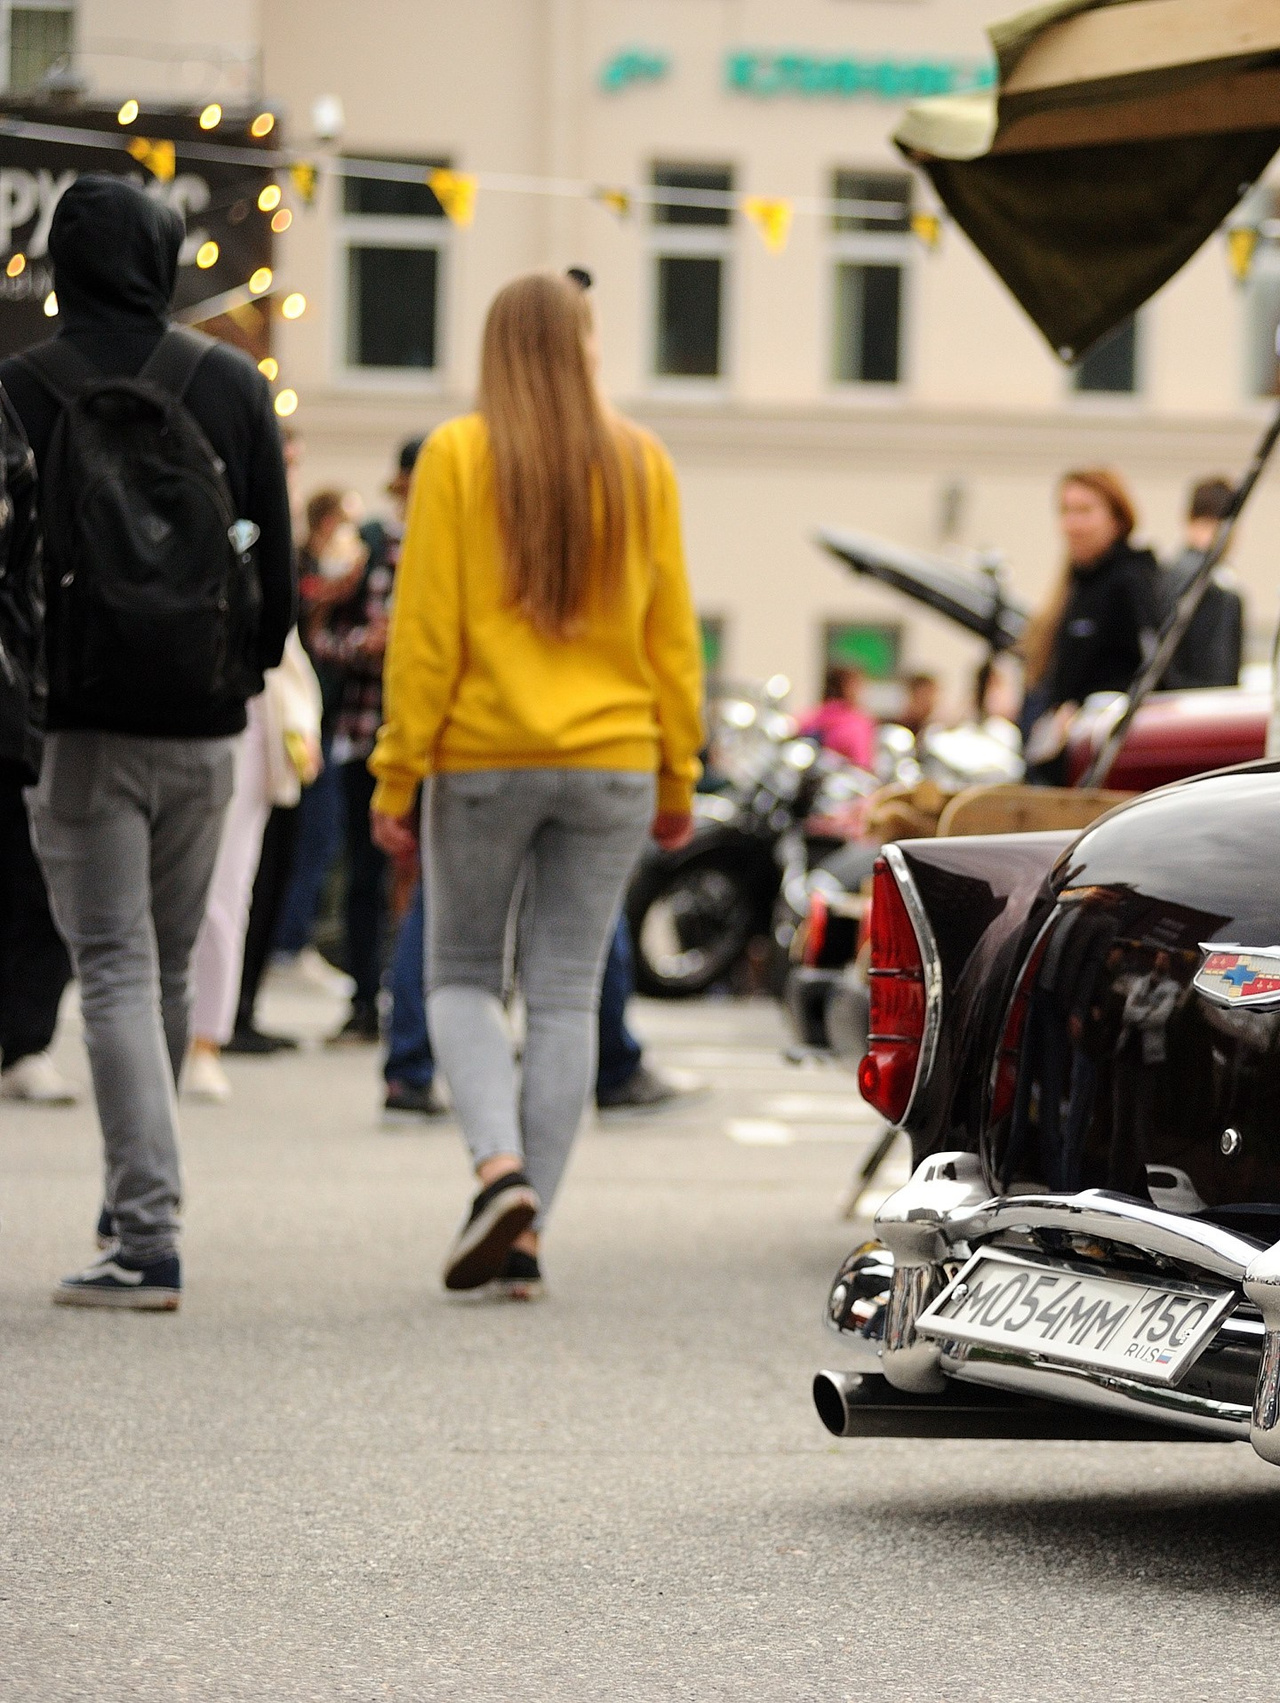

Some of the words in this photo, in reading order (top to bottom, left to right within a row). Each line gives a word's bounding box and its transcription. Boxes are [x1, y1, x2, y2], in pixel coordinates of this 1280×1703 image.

[950, 1272, 1130, 1350] M054MM
[1133, 1293, 1209, 1348] 150
[1124, 1342, 1160, 1363] RUS
